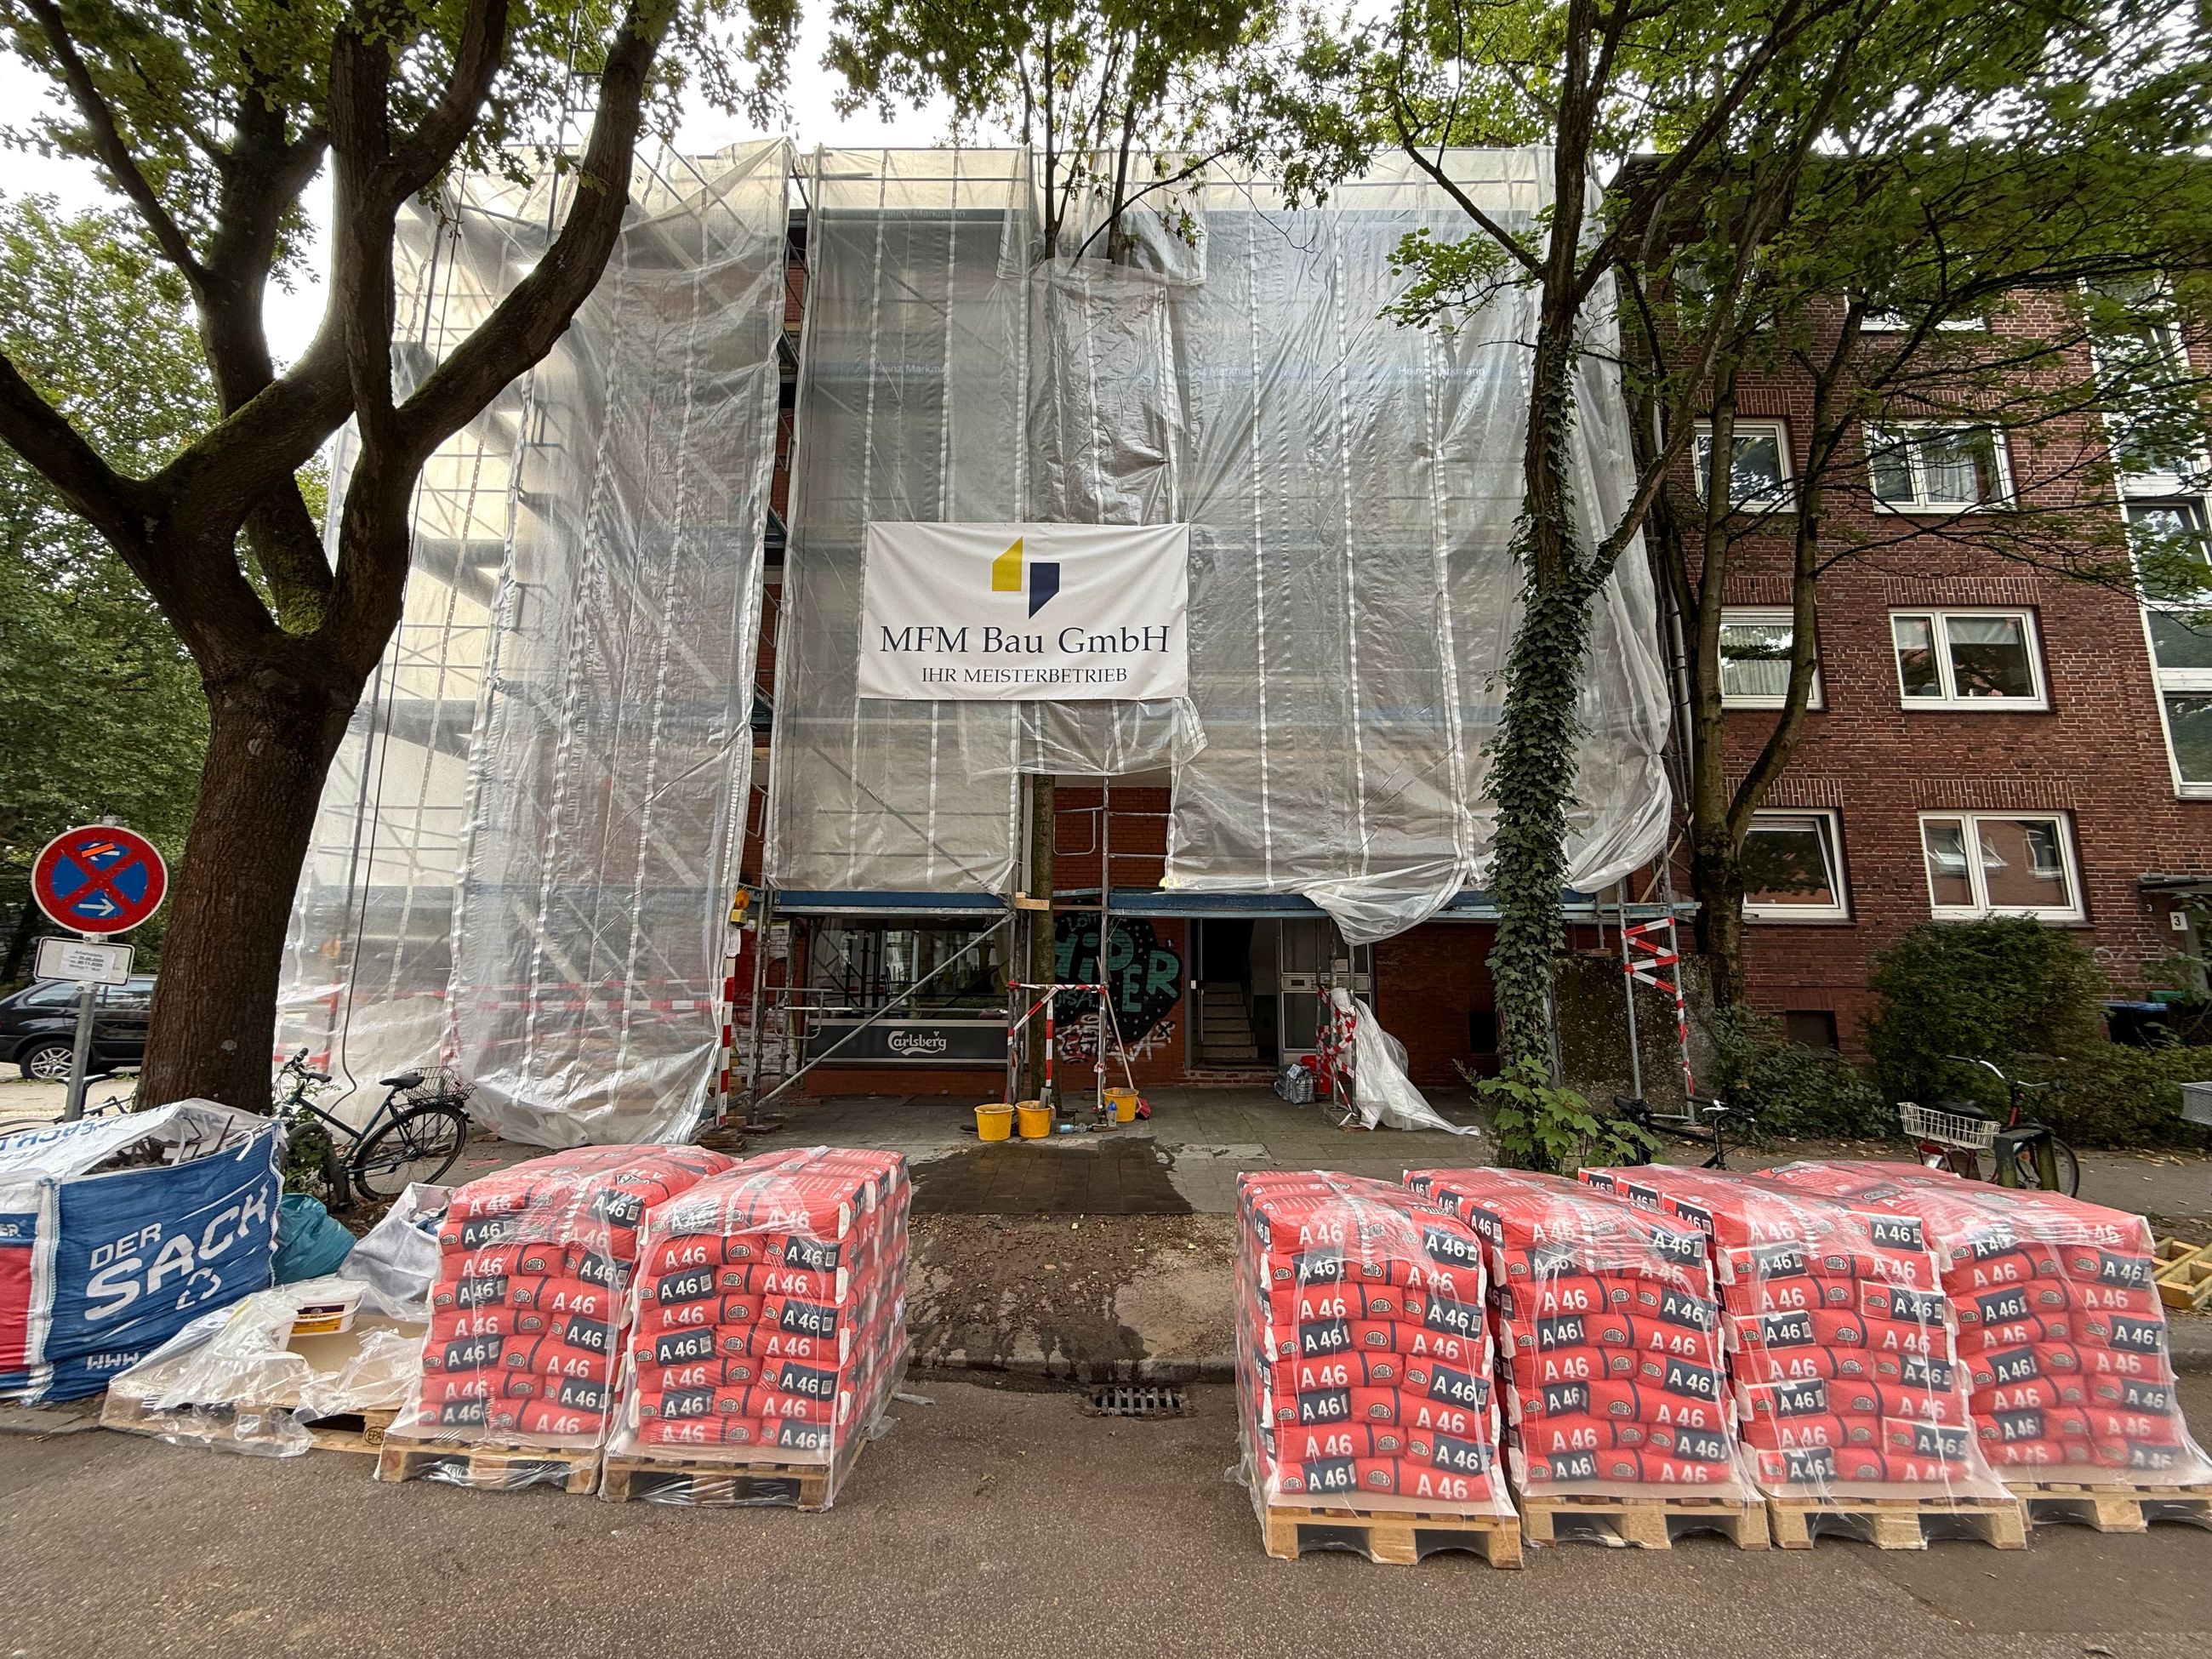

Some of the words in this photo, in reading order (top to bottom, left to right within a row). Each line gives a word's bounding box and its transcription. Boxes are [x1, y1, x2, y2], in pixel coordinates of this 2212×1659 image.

[880, 626, 968, 653] MFM
[983, 628, 1043, 653] Bau
[1058, 626, 1170, 653] GmbH
[922, 669, 955, 681] IHR
[965, 668, 1127, 683] MEISTERBETRIEB
[2146, 904, 2152, 912] 3
[2174, 915, 2181, 926] 3
[887, 1030, 947, 1052] Carlsberg
[593, 1196, 605, 1209] A
[604, 1200, 627, 1217] 46
[465, 1229, 476, 1244] A
[478, 1223, 501, 1239] 46
[1299, 1226, 1312, 1245] A
[1317, 1223, 1343, 1243] 46
[1471, 1217, 1479, 1230] A
[1479, 1220, 1491, 1235] 46
[1874, 1224, 1887, 1240] A
[1889, 1226, 1912, 1242] 46
[85, 1180, 270, 1321] SACK
[90, 1223, 162, 1271] DER
[786, 1246, 798, 1261] A
[802, 1247, 822, 1264] 46
[1426, 1234, 1439, 1250] A
[1442, 1237, 1465, 1257] 46
[463, 1260, 473, 1276] A
[478, 1257, 503, 1275] 46
[665, 1251, 678, 1268] A
[681, 1246, 706, 1263] 46
[580, 1261, 591, 1275] A
[592, 1263, 613, 1281] 46
[1274, 1269, 1291, 1279] ARDEX
[1362, 1265, 1382, 1275] ARDEX
[1974, 1269, 1989, 1287] A
[1993, 1263, 2017, 1282] 46
[660, 1284, 673, 1299] A
[676, 1279, 698, 1296] 46
[764, 1274, 777, 1291] A
[782, 1275, 807, 1294] 46
[552, 1292, 566, 1310] A
[569, 1296, 596, 1314] 46
[1371, 1302, 1391, 1311] ARDEX
[1544, 1292, 1557, 1310] A
[1562, 1290, 1588, 1309] 46
[1760, 1290, 1774, 1308] A
[1780, 1287, 1805, 1307] 46
[1895, 1298, 1907, 1314] A
[1910, 1299, 1932, 1316] 46
[2085, 1290, 2099, 1308] A
[2103, 1290, 2128, 1308] 46
[663, 1310, 674, 1326] A
[678, 1307, 704, 1325] 46
[1301, 1299, 1313, 1319] A
[1320, 1298, 1346, 1317] 46
[1428, 1305, 1441, 1322] A
[1445, 1309, 1469, 1328] 46
[1663, 1297, 1676, 1314] A
[1679, 1303, 1702, 1322] 46
[1986, 1303, 1998, 1320] A
[1999, 1298, 2018, 1316] 46
[783, 1310, 795, 1326] A
[798, 1313, 819, 1331] 46
[1765, 1325, 1777, 1340] A
[1780, 1322, 1799, 1338] 46
[567, 1327, 579, 1342] A
[581, 1330, 601, 1347] 46
[1305, 1335, 1317, 1352] A
[1320, 1328, 1340, 1345] 46
[1365, 1333, 1386, 1344] ARDEX
[1542, 1328, 1554, 1344] A
[1557, 1323, 1577, 1340] 46
[1650, 1331, 1663, 1349] A
[1668, 1336, 1696, 1354] 46
[1883, 1331, 1898, 1349] A
[1904, 1333, 1930, 1353] 46
[2114, 1326, 2128, 1343] A
[2131, 1327, 2153, 1345] 46
[448, 1351, 459, 1365] A
[463, 1345, 486, 1362] 46
[659, 1343, 672, 1360] A
[675, 1340, 698, 1356] 46
[766, 1337, 779, 1355] A
[784, 1338, 810, 1357] 46
[1412, 1334, 1426, 1354] A
[1433, 1338, 1459, 1359] 46
[547, 1356, 559, 1375] A
[563, 1360, 590, 1377] 46
[1372, 1367, 1394, 1377] ARDEX
[1545, 1361, 1558, 1379] A
[1564, 1357, 1589, 1377] 46
[1769, 1361, 1784, 1379] A
[1790, 1358, 1817, 1377] 46
[1998, 1365, 2010, 1382] A
[2013, 1359, 2030, 1377] 46
[2096, 1353, 2111, 1371] A
[2114, 1354, 2141, 1374] 46
[782, 1372, 794, 1388] A
[796, 1376, 818, 1393] 46
[1302, 1367, 1314, 1387] A
[1320, 1364, 1348, 1384] 46
[1668, 1368, 1683, 1387] A
[1686, 1372, 1709, 1392] 46
[561, 1388, 572, 1402] A
[575, 1391, 596, 1407] 46
[1433, 1377, 1446, 1394] A
[1451, 1380, 1474, 1400] 46
[1548, 1394, 1561, 1410] A
[1564, 1388, 1579, 1405] 46
[664, 1400, 676, 1415] A
[681, 1397, 703, 1413] 46
[1303, 1403, 1314, 1420] A
[1318, 1398, 1340, 1415] 46
[1780, 1395, 1792, 1411] A
[1794, 1390, 1814, 1406] 46
[1277, 1408, 1294, 1418] ARDEX
[1369, 1406, 1390, 1417] ARDEX
[1417, 1407, 1430, 1428] A
[1437, 1412, 1465, 1433] 46
[1657, 1404, 1671, 1422] A
[1677, 1407, 1704, 1427] 46
[536, 1415, 548, 1432] A
[553, 1417, 580, 1434] 46
[1553, 1431, 1566, 1449] A
[1571, 1428, 1597, 1447] 46
[1309, 1474, 1321, 1491] A
[1325, 1468, 1347, 1485] 46
[1417, 1474, 1431, 1494] A
[1438, 1478, 1467, 1499] 46
